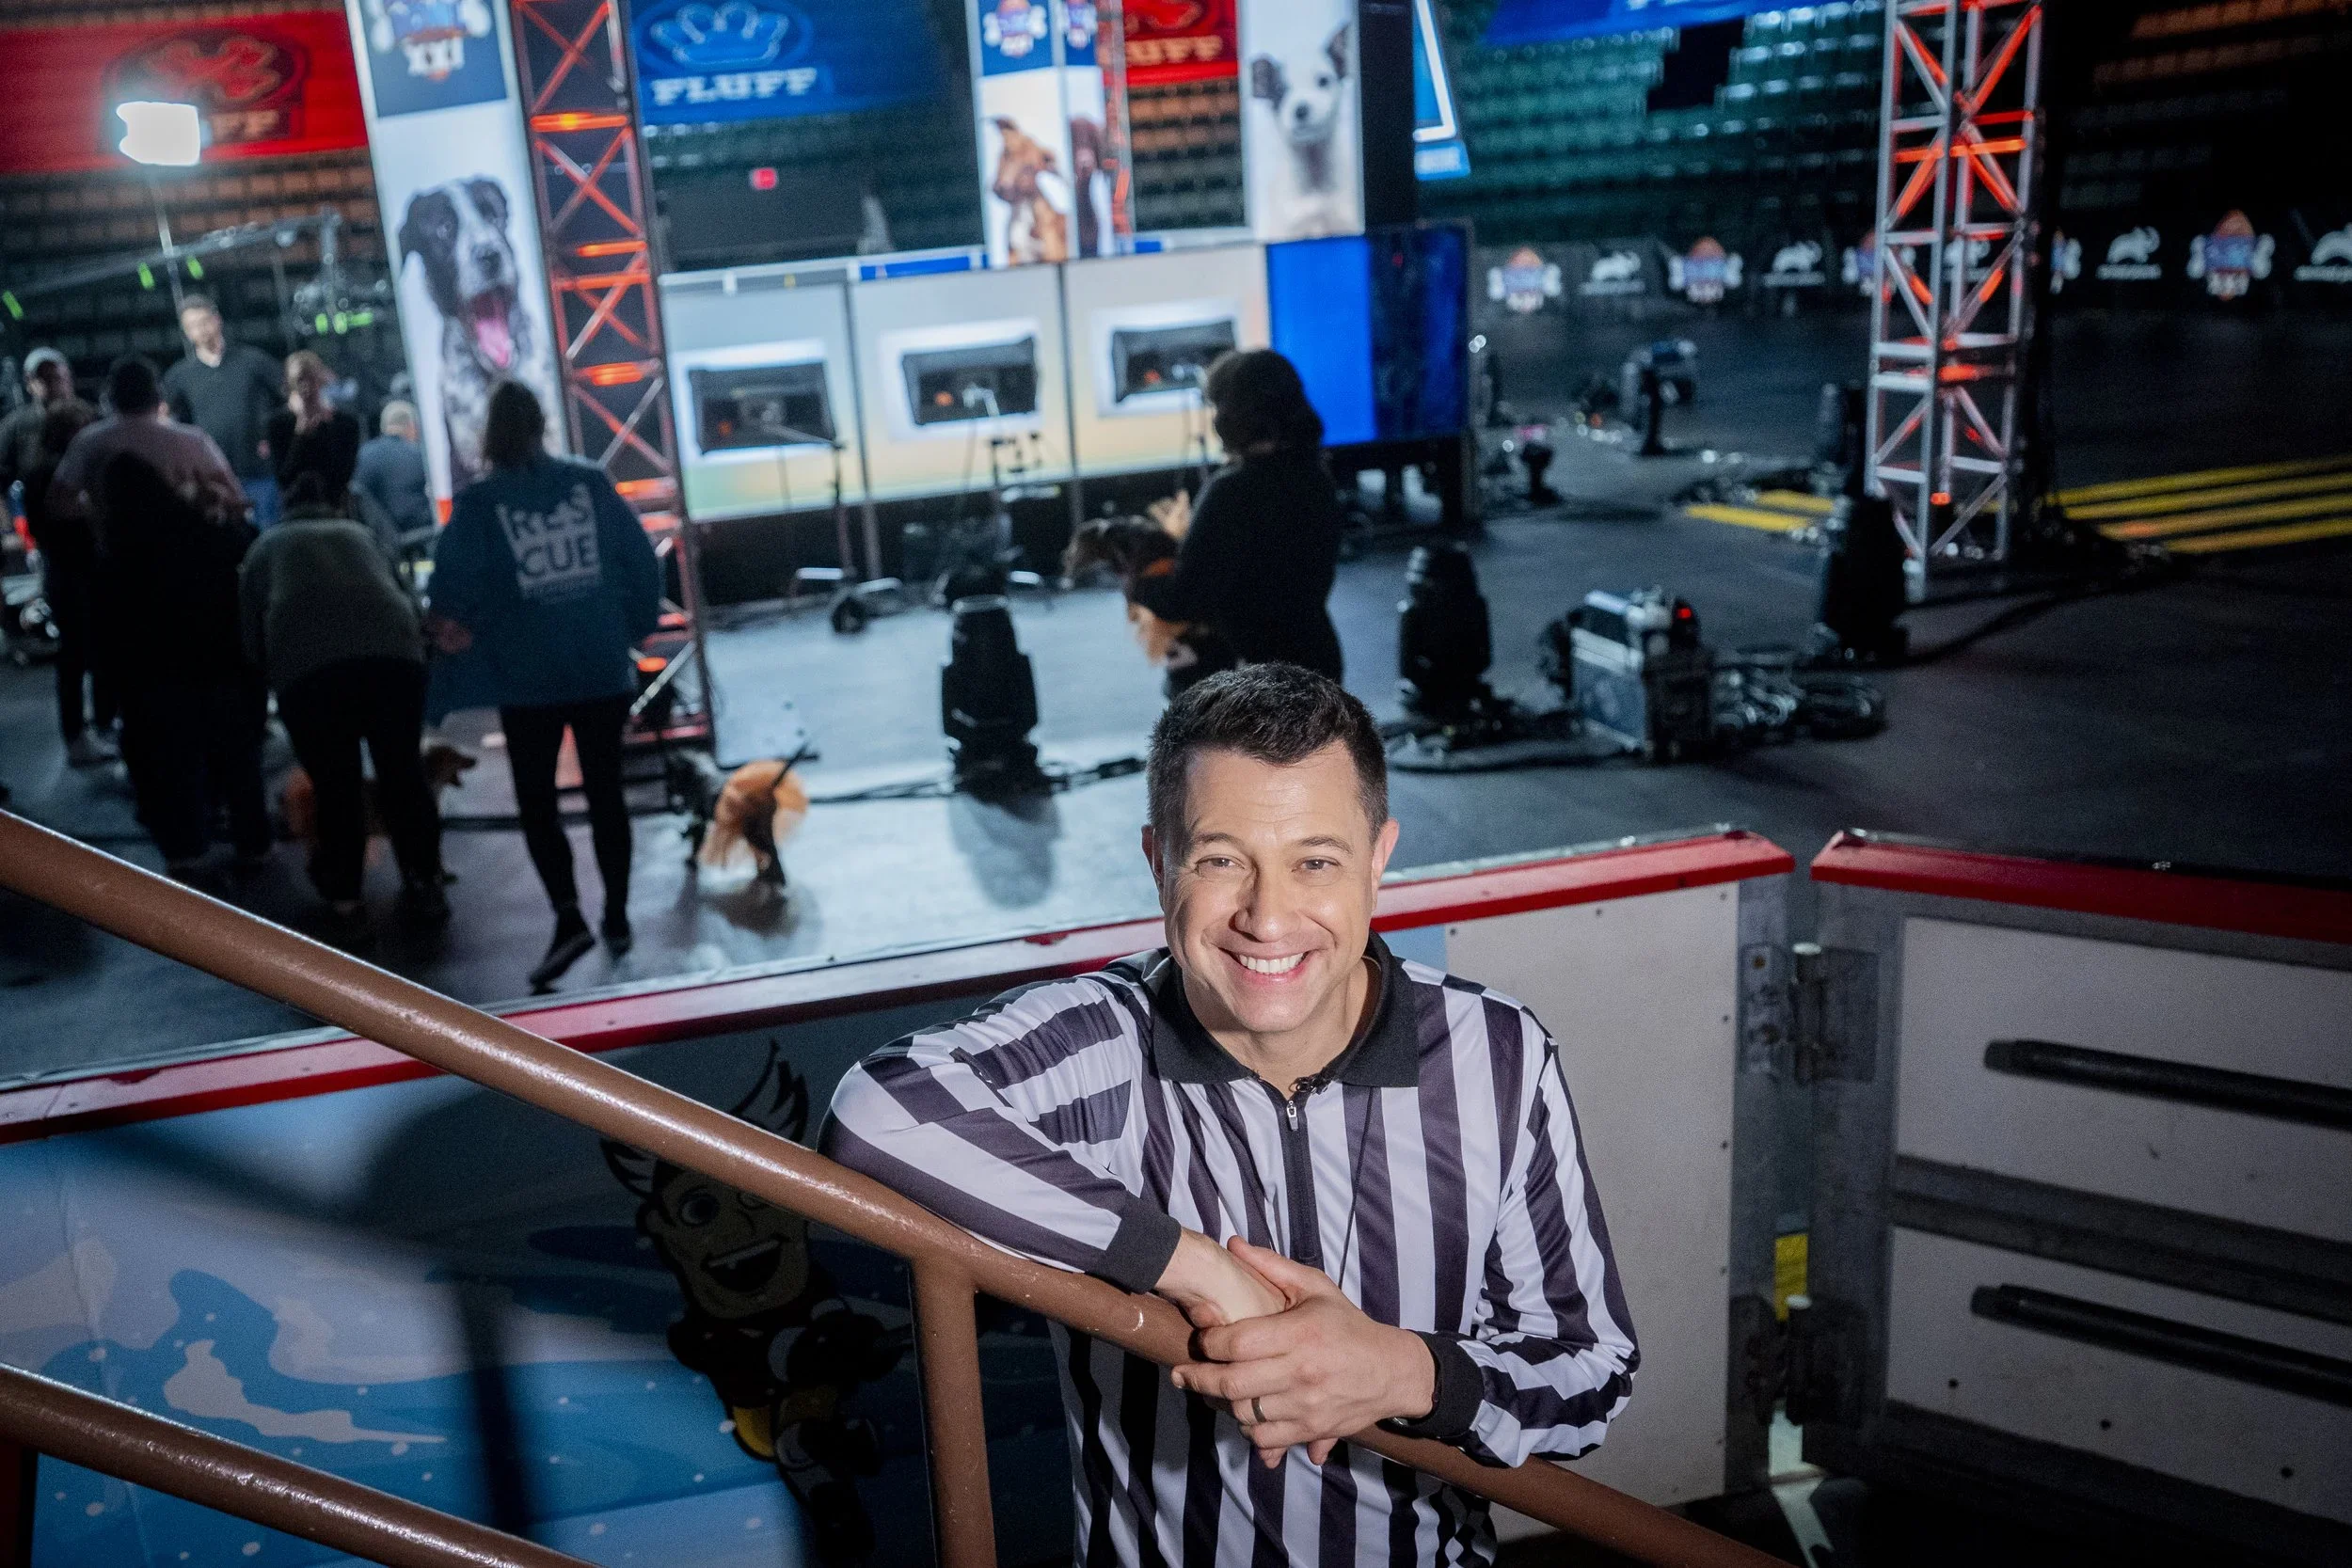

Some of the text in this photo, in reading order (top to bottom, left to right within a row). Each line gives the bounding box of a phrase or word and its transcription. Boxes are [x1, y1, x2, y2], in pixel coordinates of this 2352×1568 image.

[651, 66, 818, 106] FLUFF
[509, 491, 590, 541] RES
[517, 532, 596, 578] CUE
